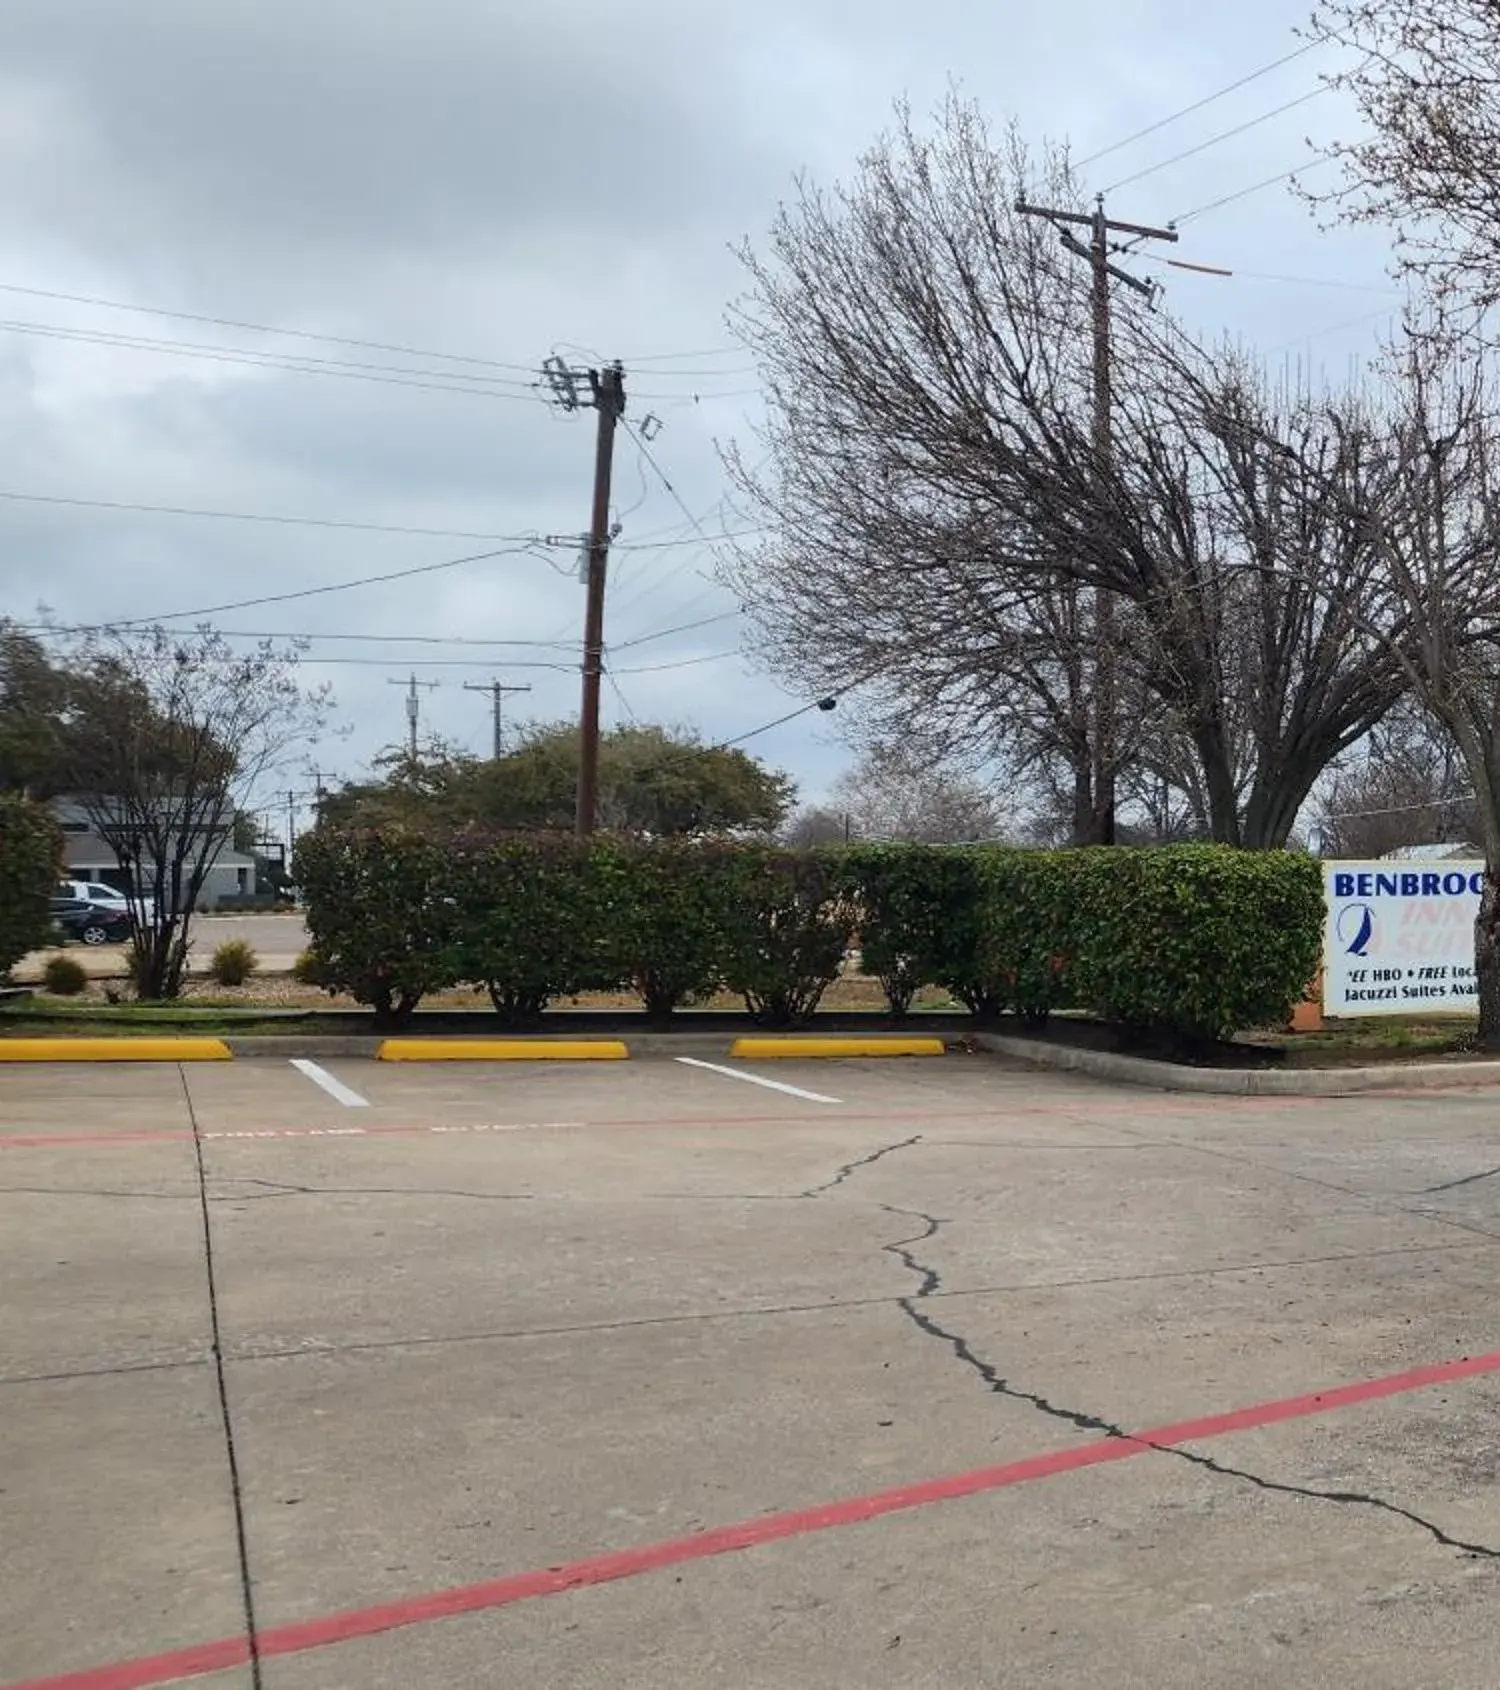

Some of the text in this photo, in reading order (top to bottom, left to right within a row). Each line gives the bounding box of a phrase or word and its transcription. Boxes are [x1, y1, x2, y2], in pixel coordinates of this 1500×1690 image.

[1373, 968, 1402, 982] HBO
[1418, 965, 1448, 980] FREE
[1345, 985, 1397, 1002] Jacuzzi
[1401, 984, 1446, 999] Suites
